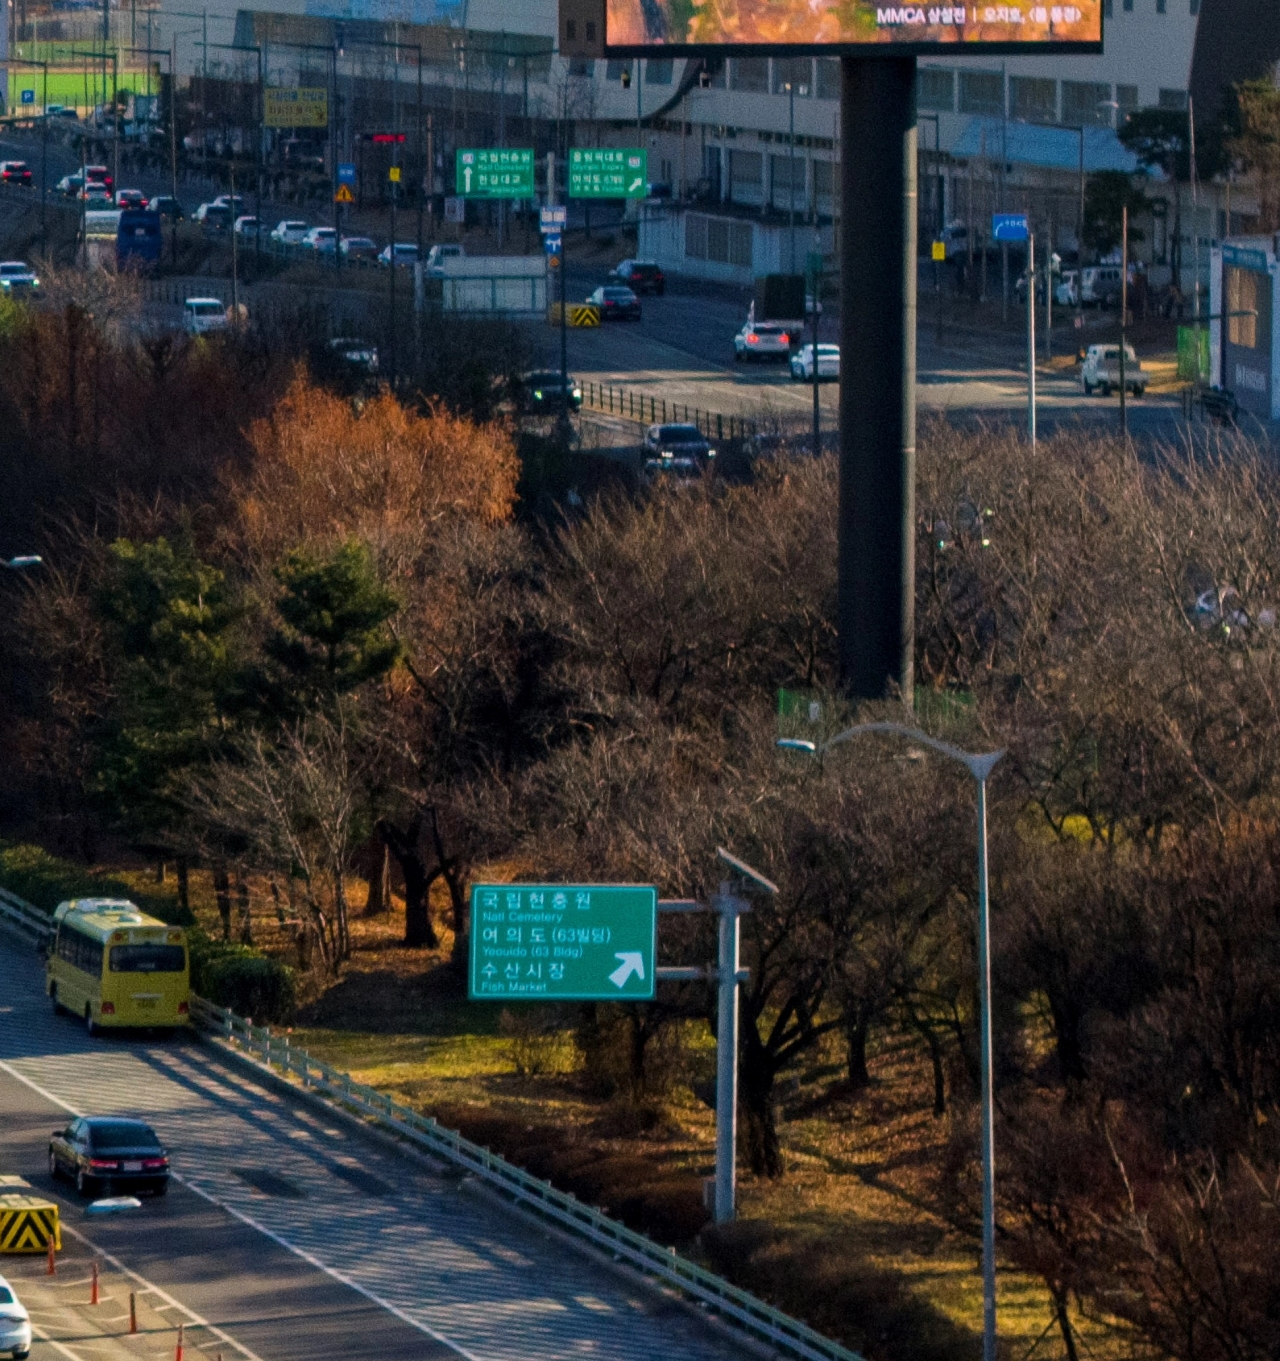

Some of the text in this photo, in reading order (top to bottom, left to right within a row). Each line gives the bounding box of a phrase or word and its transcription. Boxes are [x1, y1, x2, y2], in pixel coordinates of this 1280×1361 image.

[876, 7, 926, 24] MMCA
[927, 6, 966, 25] 상설전
[573, 151, 625, 163] 올림픽대로
[482, 891, 591, 910] 국립현충원
[482, 911, 564, 924] Natl Cemetery
[482, 926, 612, 944] 여의도 (63빌딩)
[482, 946, 584, 959] Yeouido (63 Bldg)
[481, 961, 565, 980] 수산시장
[481, 982, 547, 992] Fish Market
